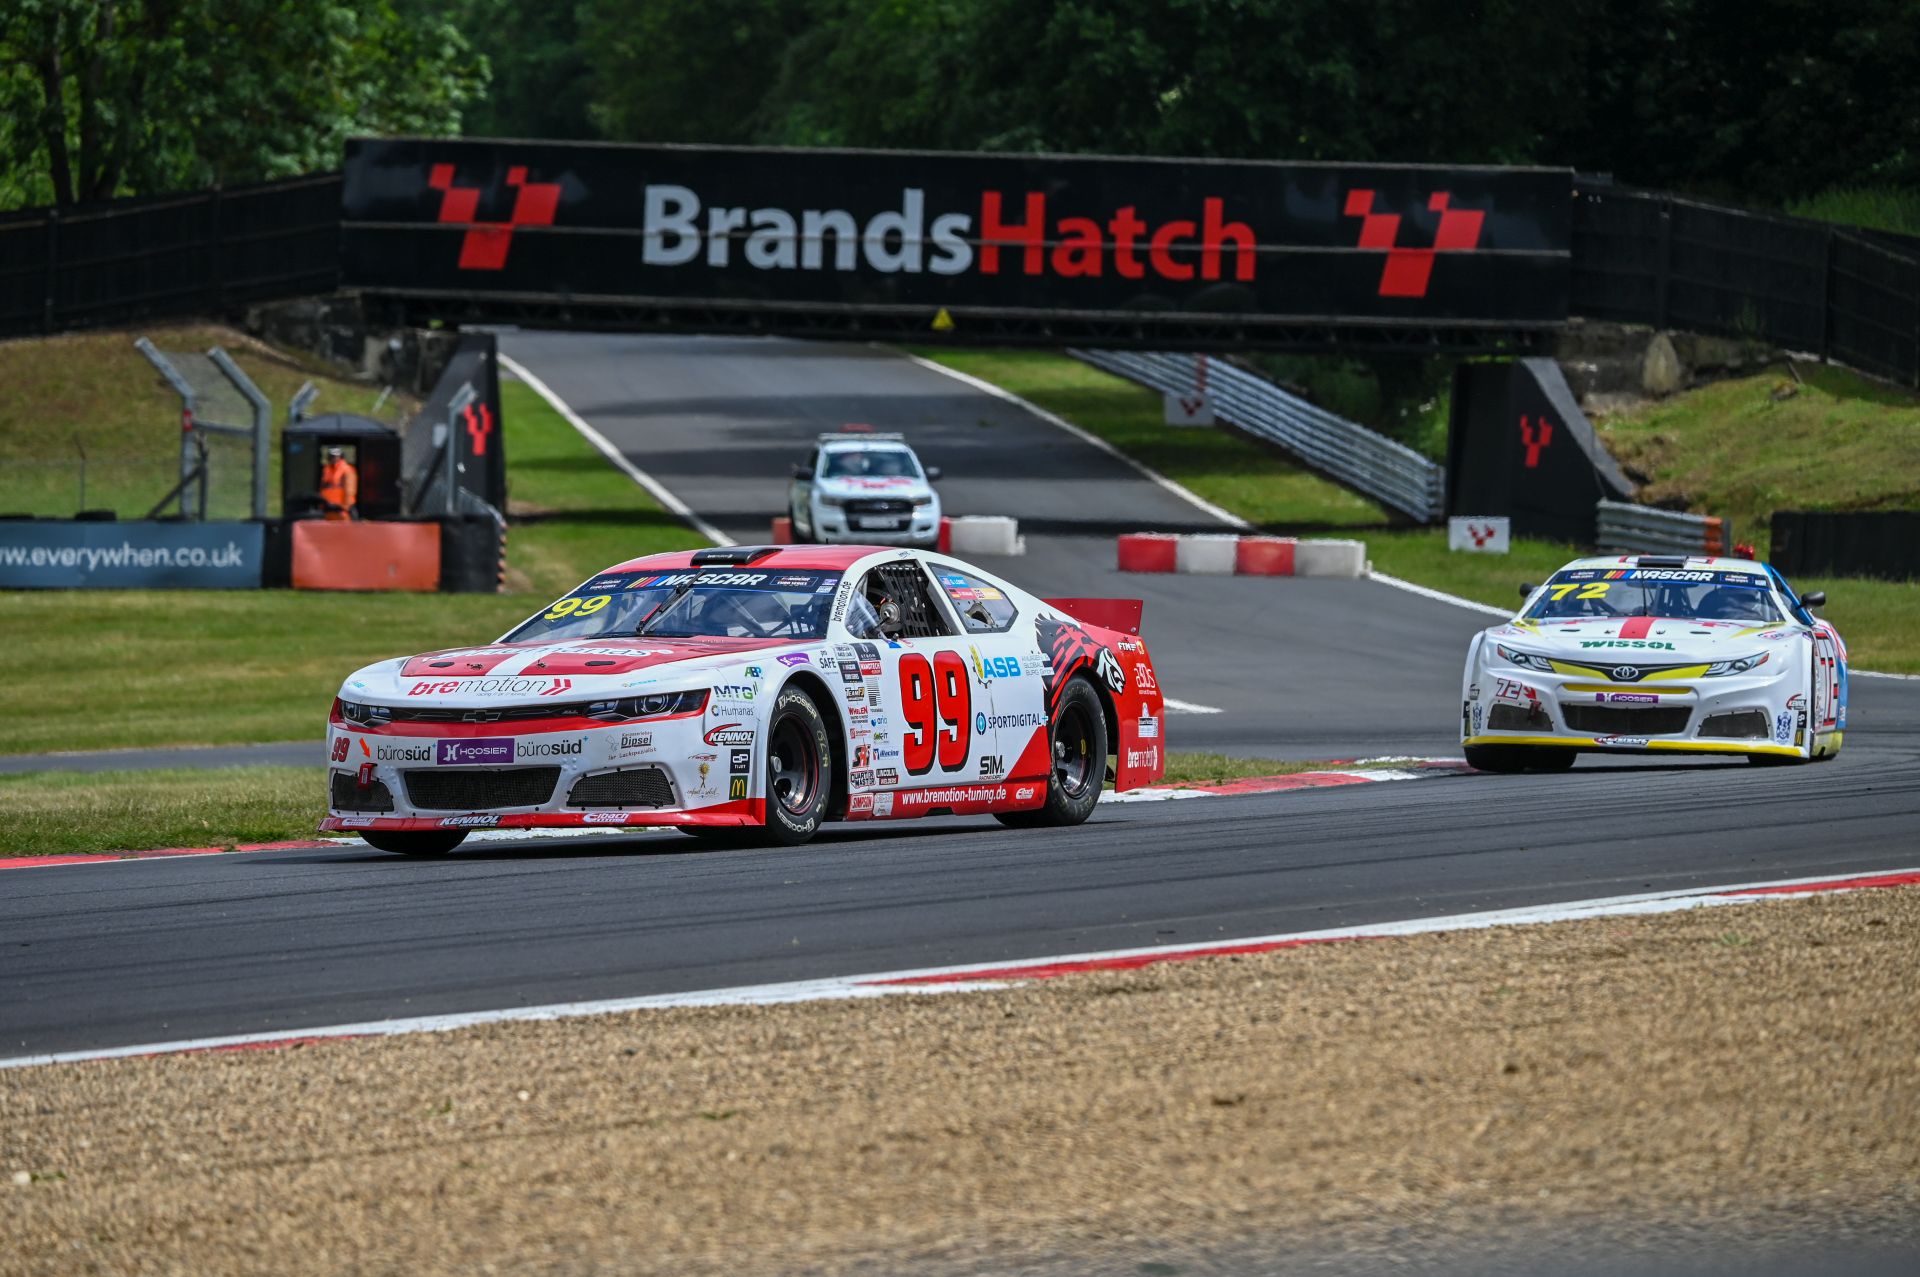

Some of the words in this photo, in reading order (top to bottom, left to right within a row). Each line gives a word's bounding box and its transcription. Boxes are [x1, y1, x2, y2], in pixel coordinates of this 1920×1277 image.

[661, 573, 767, 587] NASCAR
[1630, 570, 1714, 581] NASCAR
[1550, 582, 1610, 600] 72
[544, 596, 612, 620] 99
[833, 581, 851, 622] bremotion.de
[1579, 641, 1676, 650] WISSOL
[820, 658, 836, 669] SAFE
[983, 656, 1022, 678] ASB
[408, 676, 546, 696] bremotion
[713, 685, 754, 700] MTG
[1496, 678, 1522, 699] 72
[785, 694, 817, 720] HOOSIER
[898, 650, 972, 776] 99
[621, 735, 653, 747] Dipsel
[708, 731, 755, 742] KENNOL
[331, 737, 351, 762] 99
[377, 744, 431, 762] bürosüd
[460, 746, 508, 756] HOOSIER
[517, 742, 582, 757] bürosüd
[851, 770, 874, 780] QUARTER
[855, 778, 875, 786] MASTER
[902, 786, 1006, 805] www.bremotion-tuning.de
[440, 815, 501, 826] KENNOL
